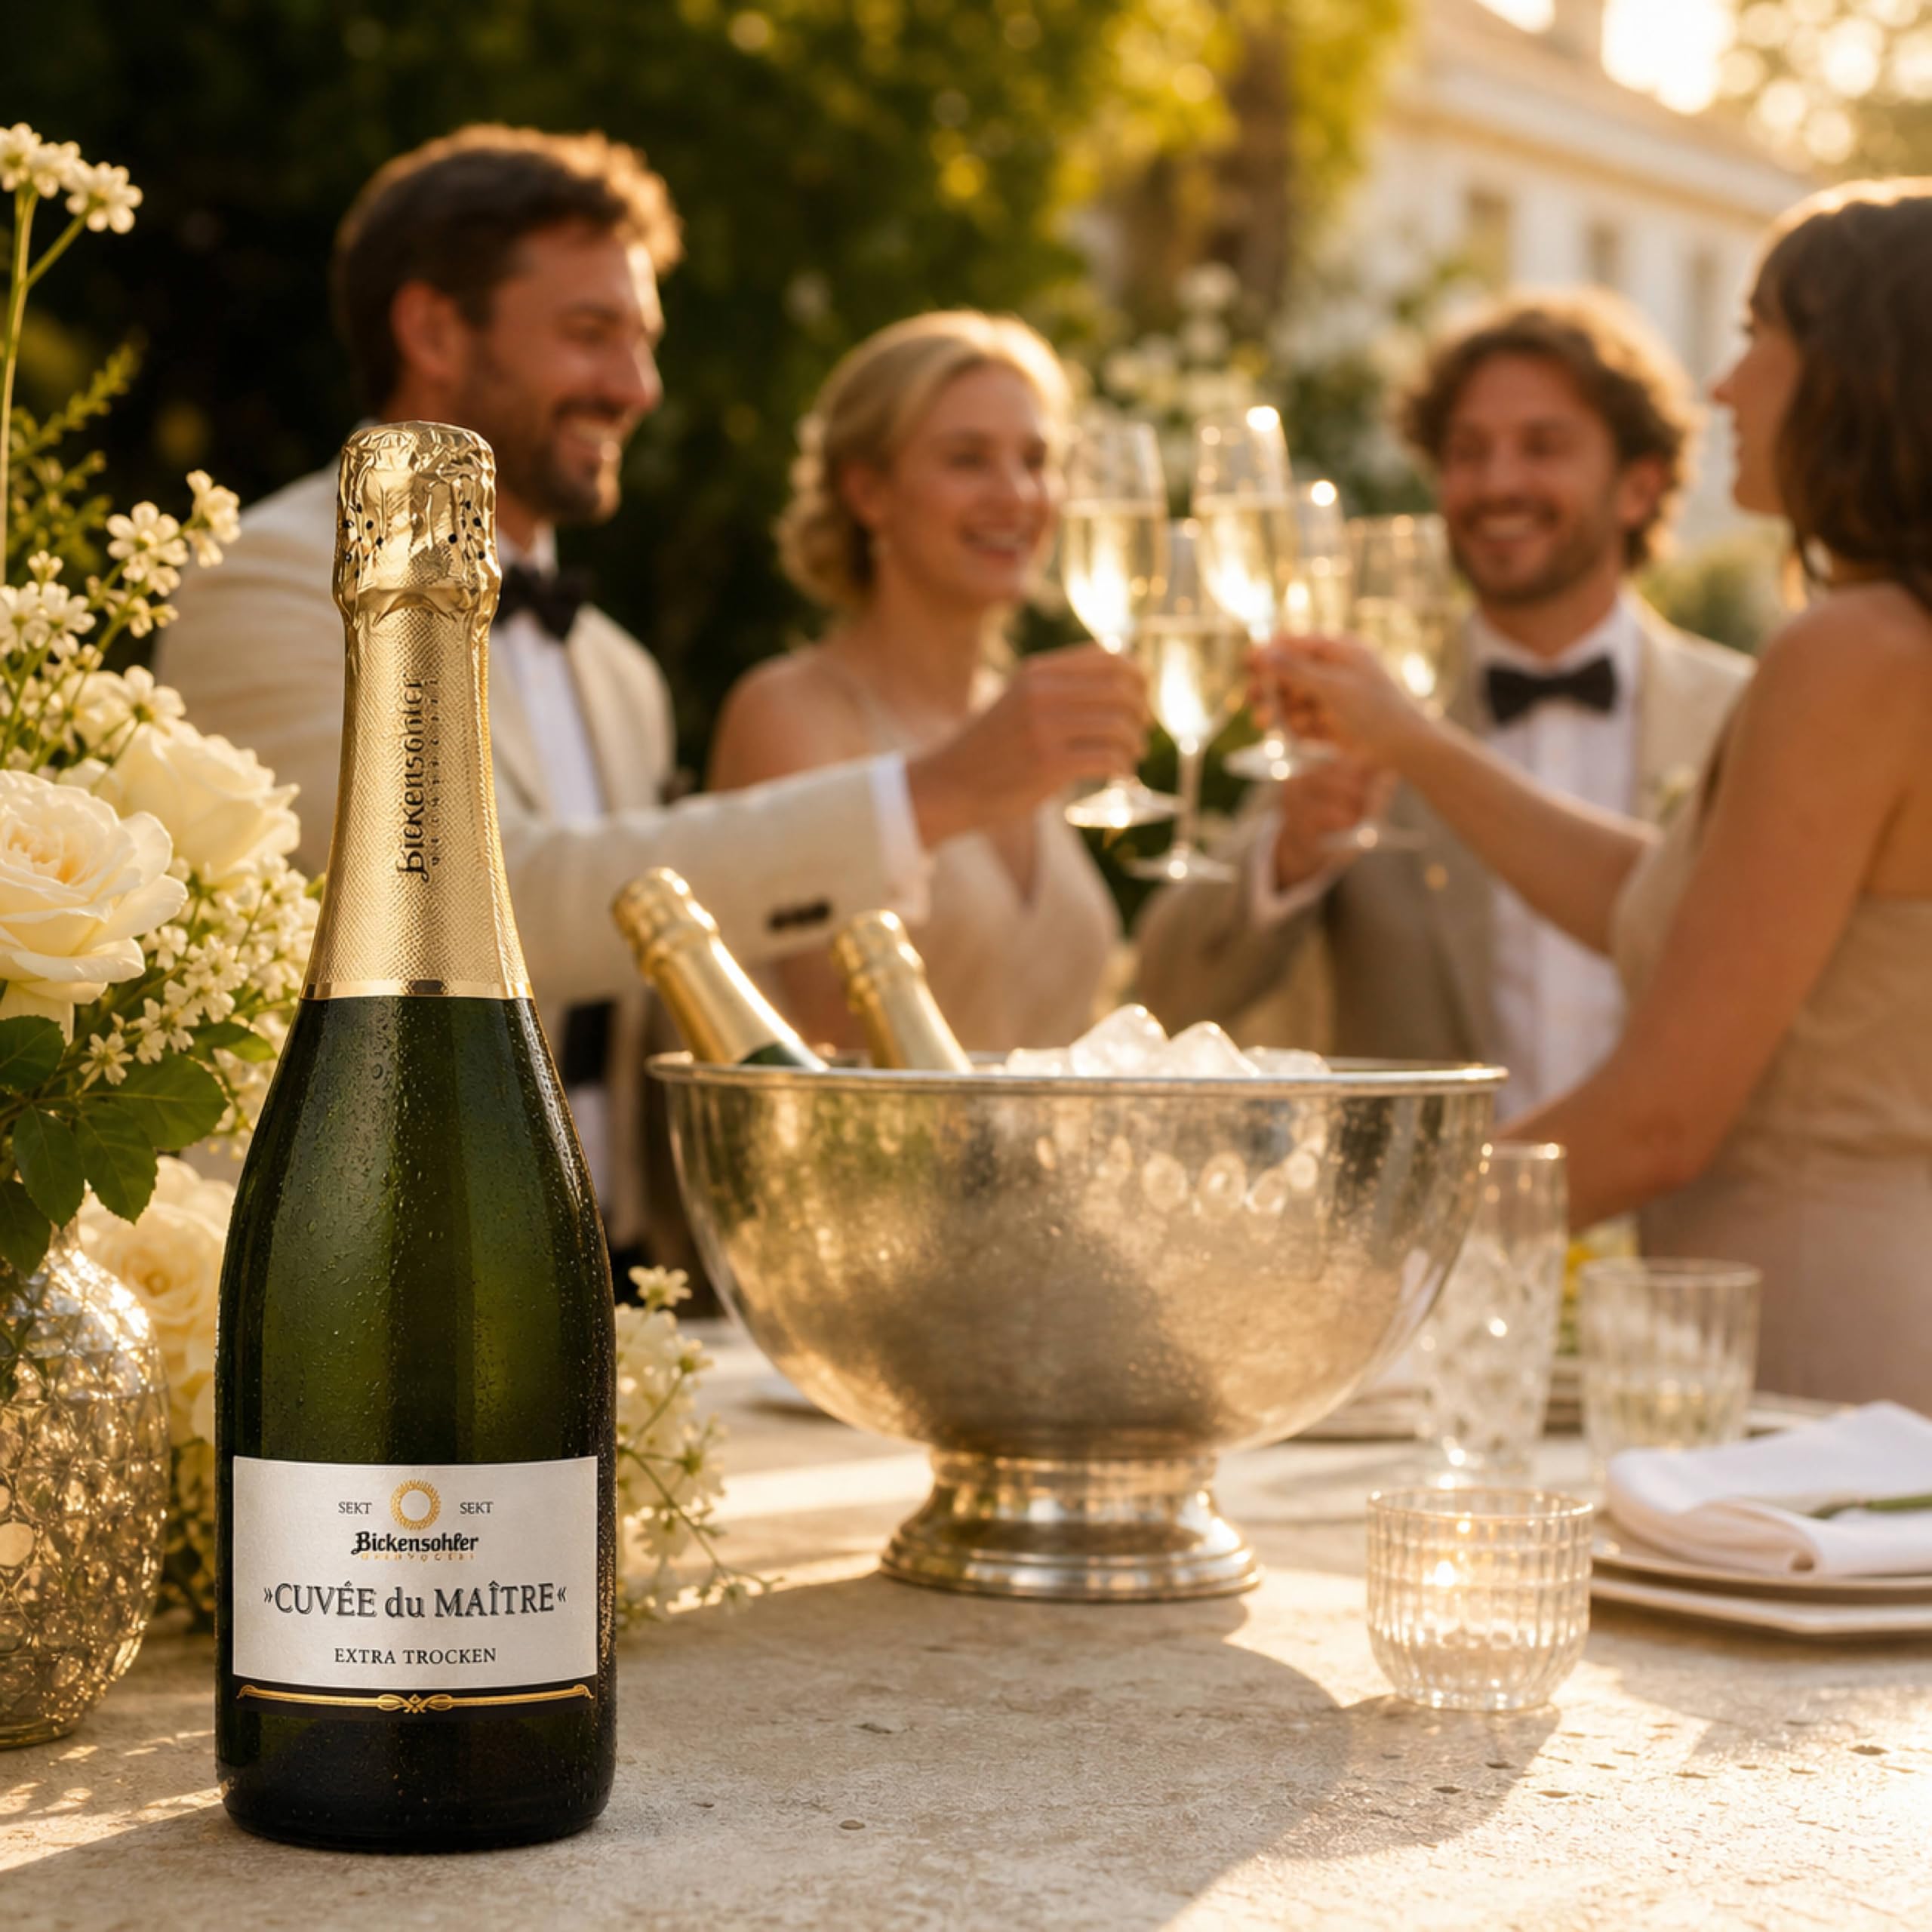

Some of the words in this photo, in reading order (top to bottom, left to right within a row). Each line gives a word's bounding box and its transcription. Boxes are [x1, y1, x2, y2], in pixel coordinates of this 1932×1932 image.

[338, 1501, 372, 1515] SEKT
[460, 1501, 494, 1515] SEKT
[264, 1581, 377, 1617] »CUVÉE
[385, 1587, 424, 1617] du
[434, 1580, 566, 1617] MAÎTRE«
[334, 1647, 396, 1665] EXTRA
[403, 1647, 497, 1665] TROCKEN
